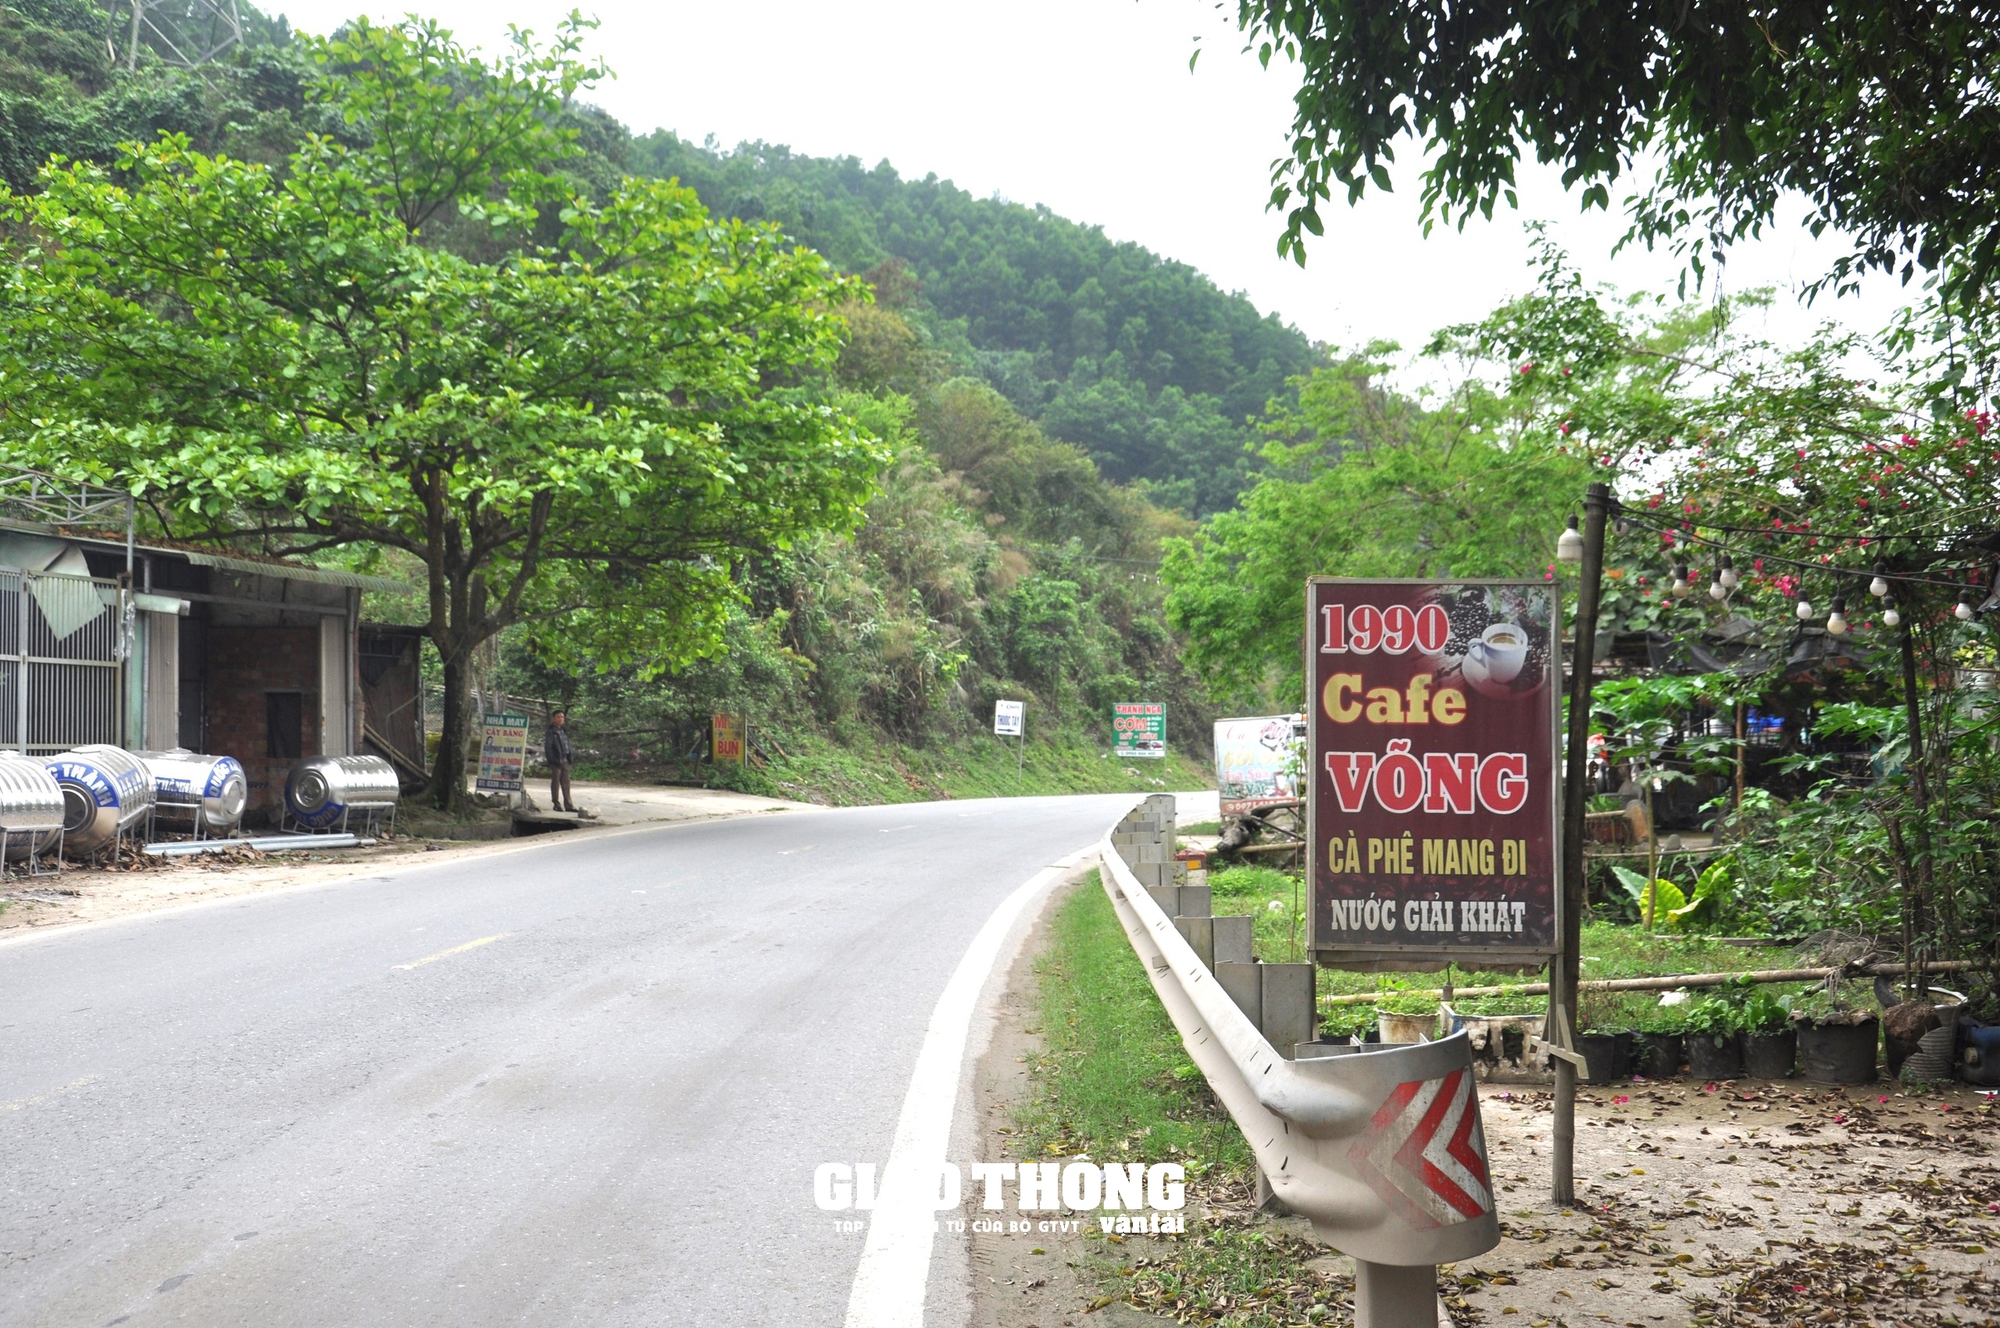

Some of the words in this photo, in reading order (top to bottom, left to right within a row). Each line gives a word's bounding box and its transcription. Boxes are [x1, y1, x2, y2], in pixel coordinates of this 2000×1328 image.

[1321, 604, 1450, 655] 1990
[1116, 705, 1143, 714] THANH
[1145, 705, 1162, 714] NGA
[1323, 673, 1467, 725] Cafe
[506, 718, 525, 727] MAY
[1114, 715, 1146, 731] CƠM
[62, 764, 114, 806] THÀNH
[1325, 739, 1528, 814] VÕNG
[1329, 831, 1361, 874] CÀ
[1368, 830, 1414, 875] PHÊ
[1422, 839, 1494, 875] MANG
[1501, 839, 1527, 876] ĐI
[1331, 893, 1397, 932] NƯỚC
[1403, 892, 1454, 932] GIẢI
[1460, 894, 1526, 933] KHÁT
